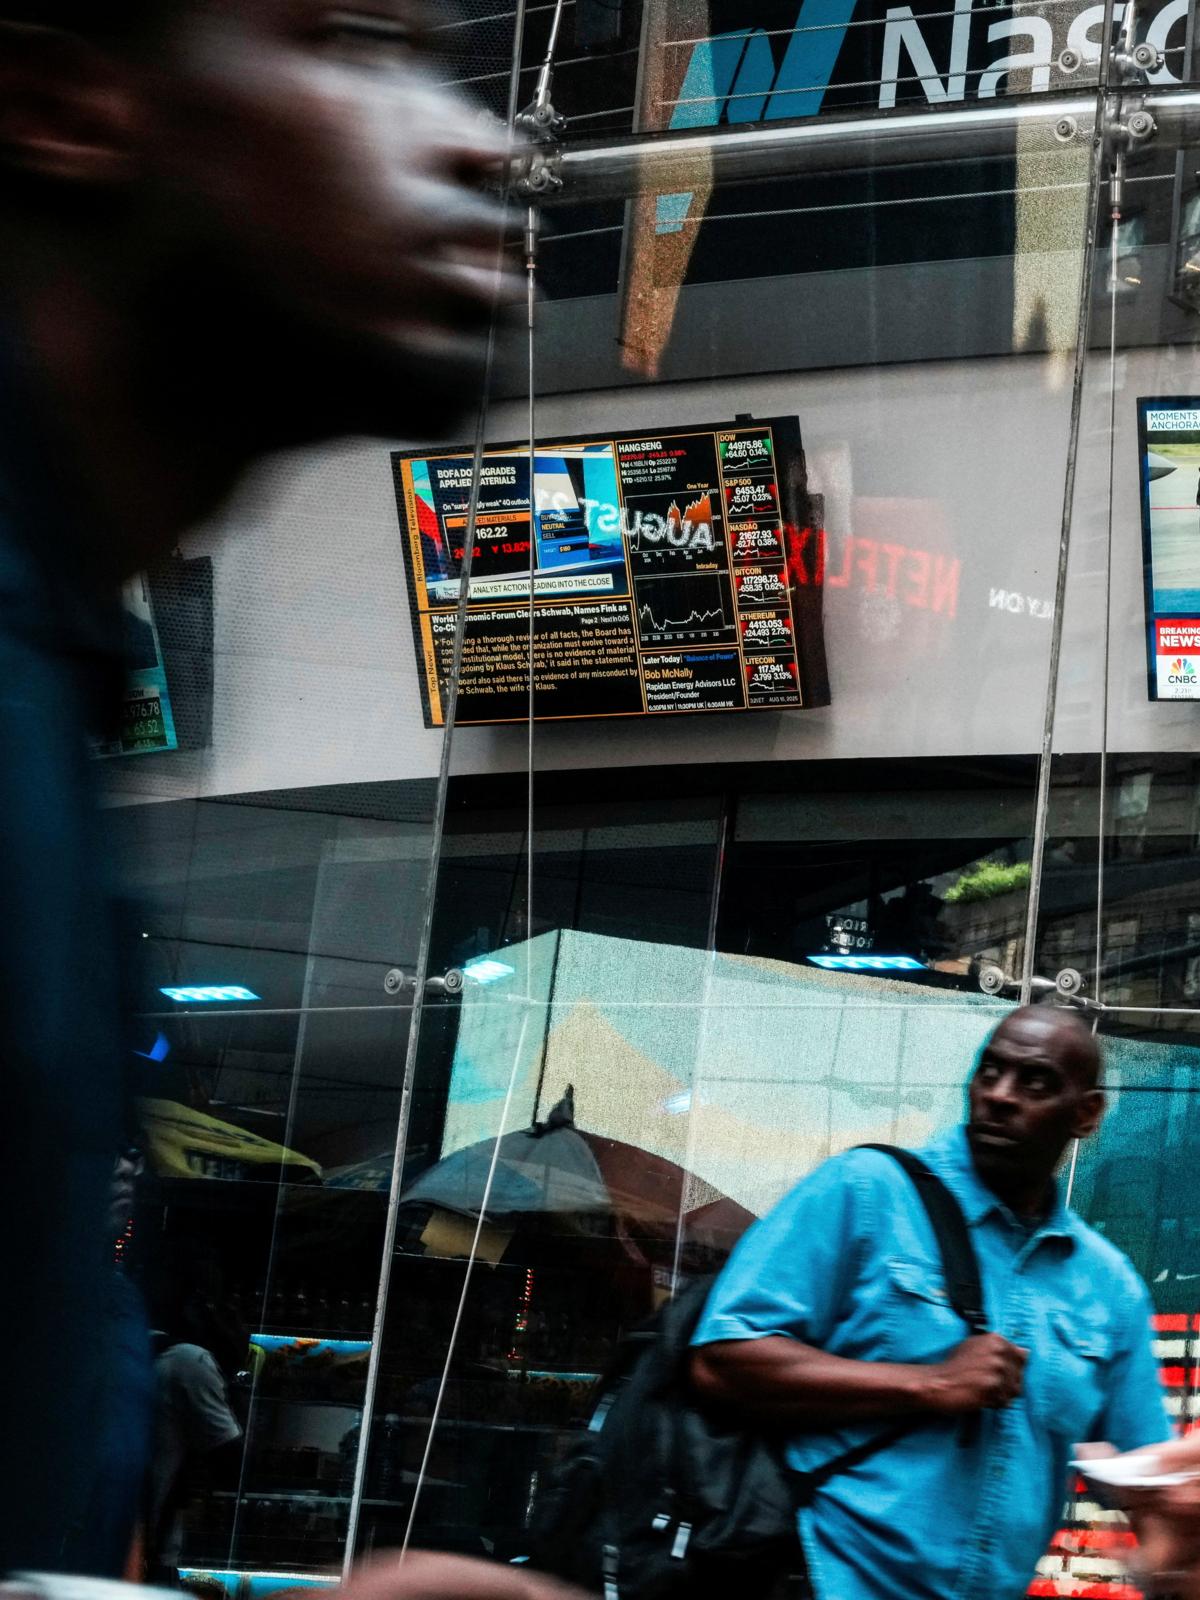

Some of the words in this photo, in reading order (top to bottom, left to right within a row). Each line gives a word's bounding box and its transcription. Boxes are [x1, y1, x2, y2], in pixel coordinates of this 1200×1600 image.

[1150, 412, 1198, 421] MOMENTS
[720, 434, 736, 442] DOW
[619, 443, 640, 453] HANG
[641, 441, 662, 451] SENG
[728, 439, 763, 450] 44975.86
[725, 449, 747, 458] +64.60
[749, 447, 768, 456] 0.14%
[437, 468, 460, 479] BOFA
[440, 479, 473, 489] APPLIED
[474, 476, 516, 486] ATERIALS
[724, 479, 738, 487] S&P
[735, 485, 765, 495] 6453.47
[731, 495, 750, 503] -15.07
[752, 493, 773, 502] 0.23%
[407, 488, 417, 531] Television
[443, 503, 452, 511] On
[476, 526, 508, 539] 162.22
[730, 523, 758, 531] NASDAQ
[413, 534, 424, 582] Bloomberg
[735, 567, 762, 576] BITCOIN
[473, 584, 502, 594] ANALYST
[503, 583, 528, 592] ACTION
[557, 580, 573, 589] INTO
[573, 579, 588, 587] THE
[588, 577, 611, 586] CLOSE
[432, 615, 454, 624] World
[491, 611, 516, 620] Forum
[574, 606, 600, 615] Names
[600, 604, 618, 613] Fink
[740, 611, 776, 621] ETHEREUM
[482, 635, 515, 645] thorough
[540, 632, 548, 640] of
[550, 631, 559, 639] all
[581, 629, 594, 637] the
[594, 628, 617, 636] Board
[618, 627, 631, 635] has
[492, 644, 508, 652] while
[563, 640, 581, 648] must
[581, 639, 603, 647] evolve
[604, 637, 628, 645] toward
[564, 648, 595, 657] evidence
[597, 647, 605, 655] of
[606, 645, 635, 655] material
[485, 663, 495, 672] by
[496, 662, 516, 670] Klaus
[556, 659, 572, 667] said
[581, 657, 593, 665] the
[643, 656, 660, 664] Later
[660, 655, 681, 664] Today
[745, 656, 776, 665] LITECOIN
[478, 676, 491, 684] also
[492, 675, 505, 683] said
[506, 674, 523, 682] there
[541, 671, 569, 680] evidence
[591, 669, 629, 678] misconduct
[630, 668, 638, 677] by
[644, 670, 661, 679] Bob
[662, 667, 693, 678] McNally
[646, 682, 671, 692] Rapidan
[672, 681, 694, 690] Energy
[694, 679, 722, 688] Advisors
[722, 678, 736, 686] LLC
[1167, 675, 1198, 685] CNBC
[497, 685, 508, 693] the
[510, 684, 525, 692] wife
[647, 691, 700, 700] President/Founder
